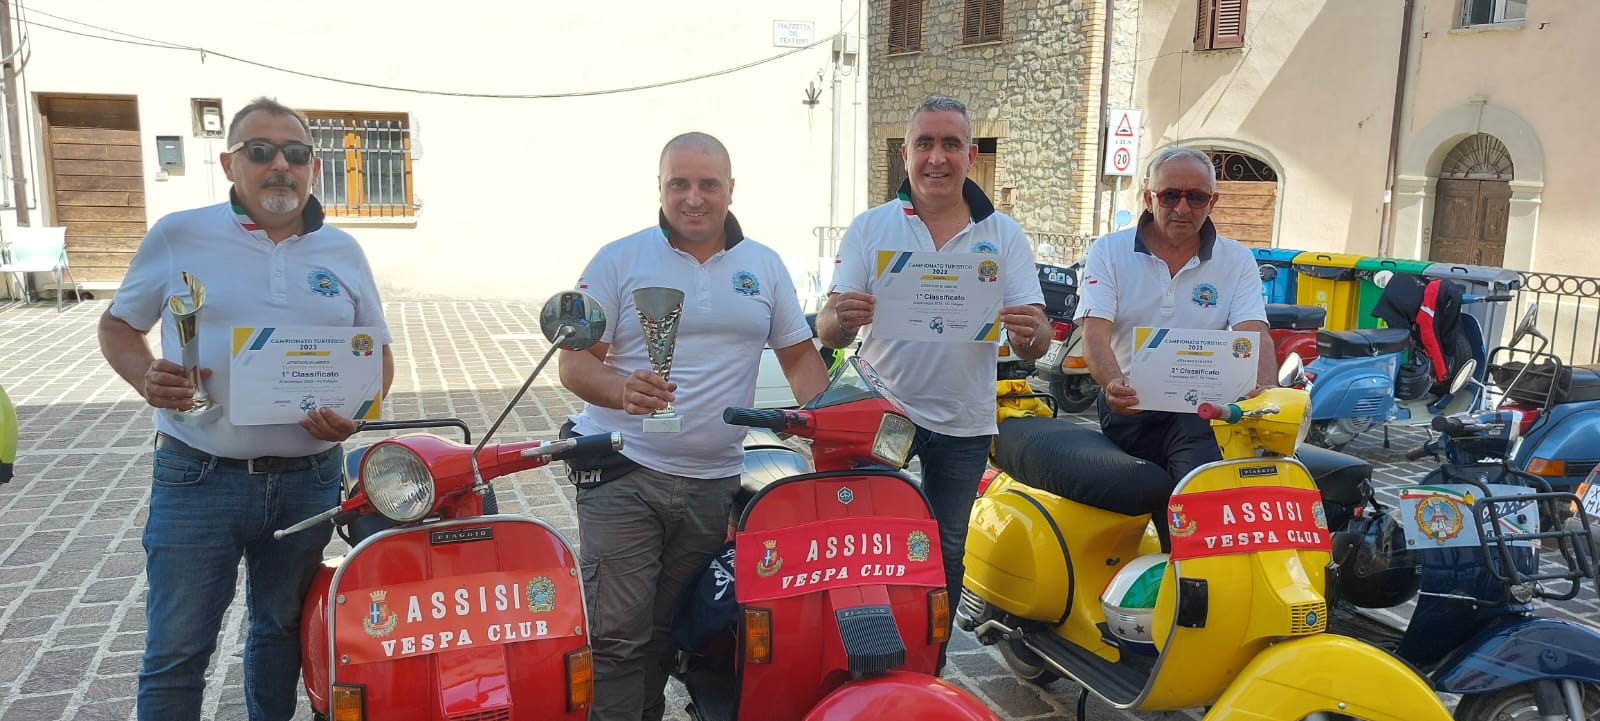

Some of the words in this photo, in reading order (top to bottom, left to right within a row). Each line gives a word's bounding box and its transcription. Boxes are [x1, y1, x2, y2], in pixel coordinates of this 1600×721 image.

[1117, 154, 1127, 165] 20
[924, 293, 965, 301] Classificato
[292, 370, 339, 378] Classificato
[1180, 368, 1220, 376] Classificato
[1223, 501, 1303, 525] ASSISI
[437, 530, 486, 540] PIAGGIO
[1204, 531, 1279, 549] VESPA
[1287, 529, 1321, 544] CLUB
[806, 533, 891, 563] ASSISI
[781, 567, 849, 590] VESPA
[860, 564, 906, 577] CLUB
[406, 583, 521, 623] ASSISI
[380, 629, 472, 657] VESPA
[487, 620, 548, 642] CLUB
